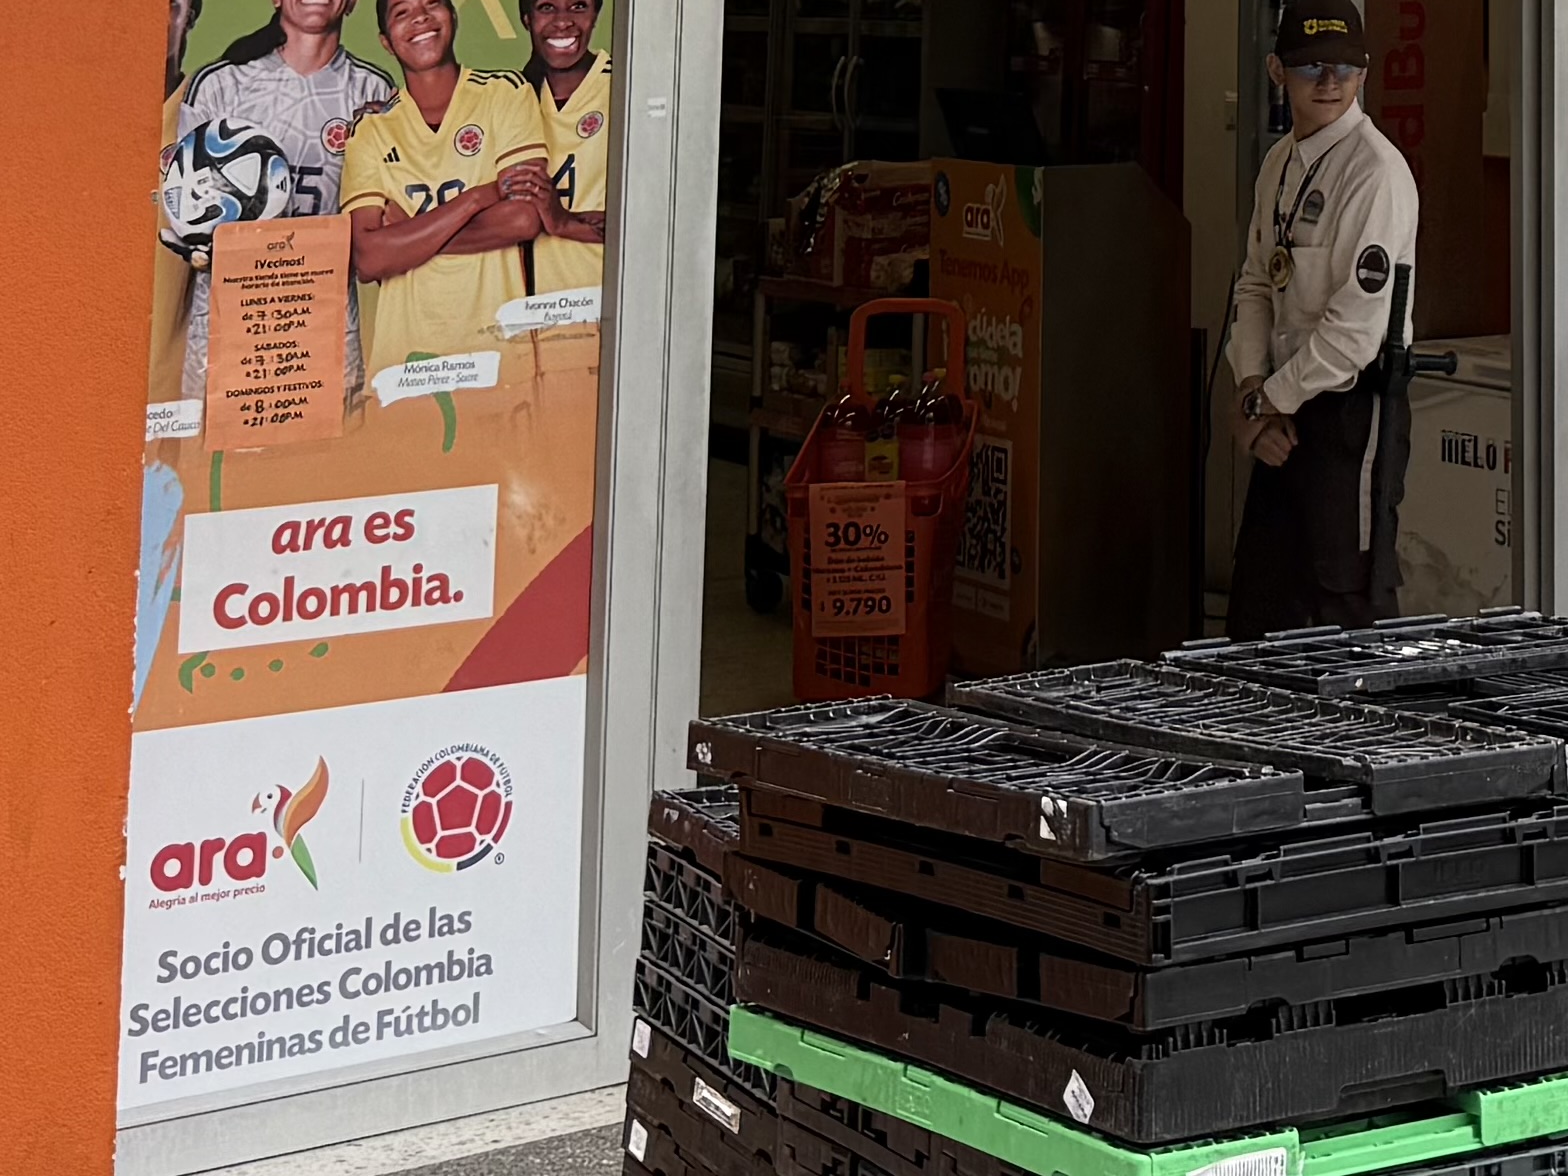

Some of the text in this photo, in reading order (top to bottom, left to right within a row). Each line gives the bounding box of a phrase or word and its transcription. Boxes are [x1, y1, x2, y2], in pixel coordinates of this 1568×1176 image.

[965, 206, 990, 229] ara
[939, 248, 1029, 295] Tenemos App
[241, 296, 268, 307] LUNES
[404, 361, 476, 374] Mónica Ramos
[271, 508, 415, 554] ara es
[825, 521, 889, 548] 30%
[213, 563, 464, 630] Colombia.
[832, 595, 892, 617] 9.790
[150, 832, 267, 892] ara
[149, 883, 265, 910] Alegría al mejor precio
[157, 906, 472, 984] Socio Oficial de las
[127, 949, 493, 1037] Selecciones Colombia
[139, 991, 481, 1084] Femeninas de Fútbol
